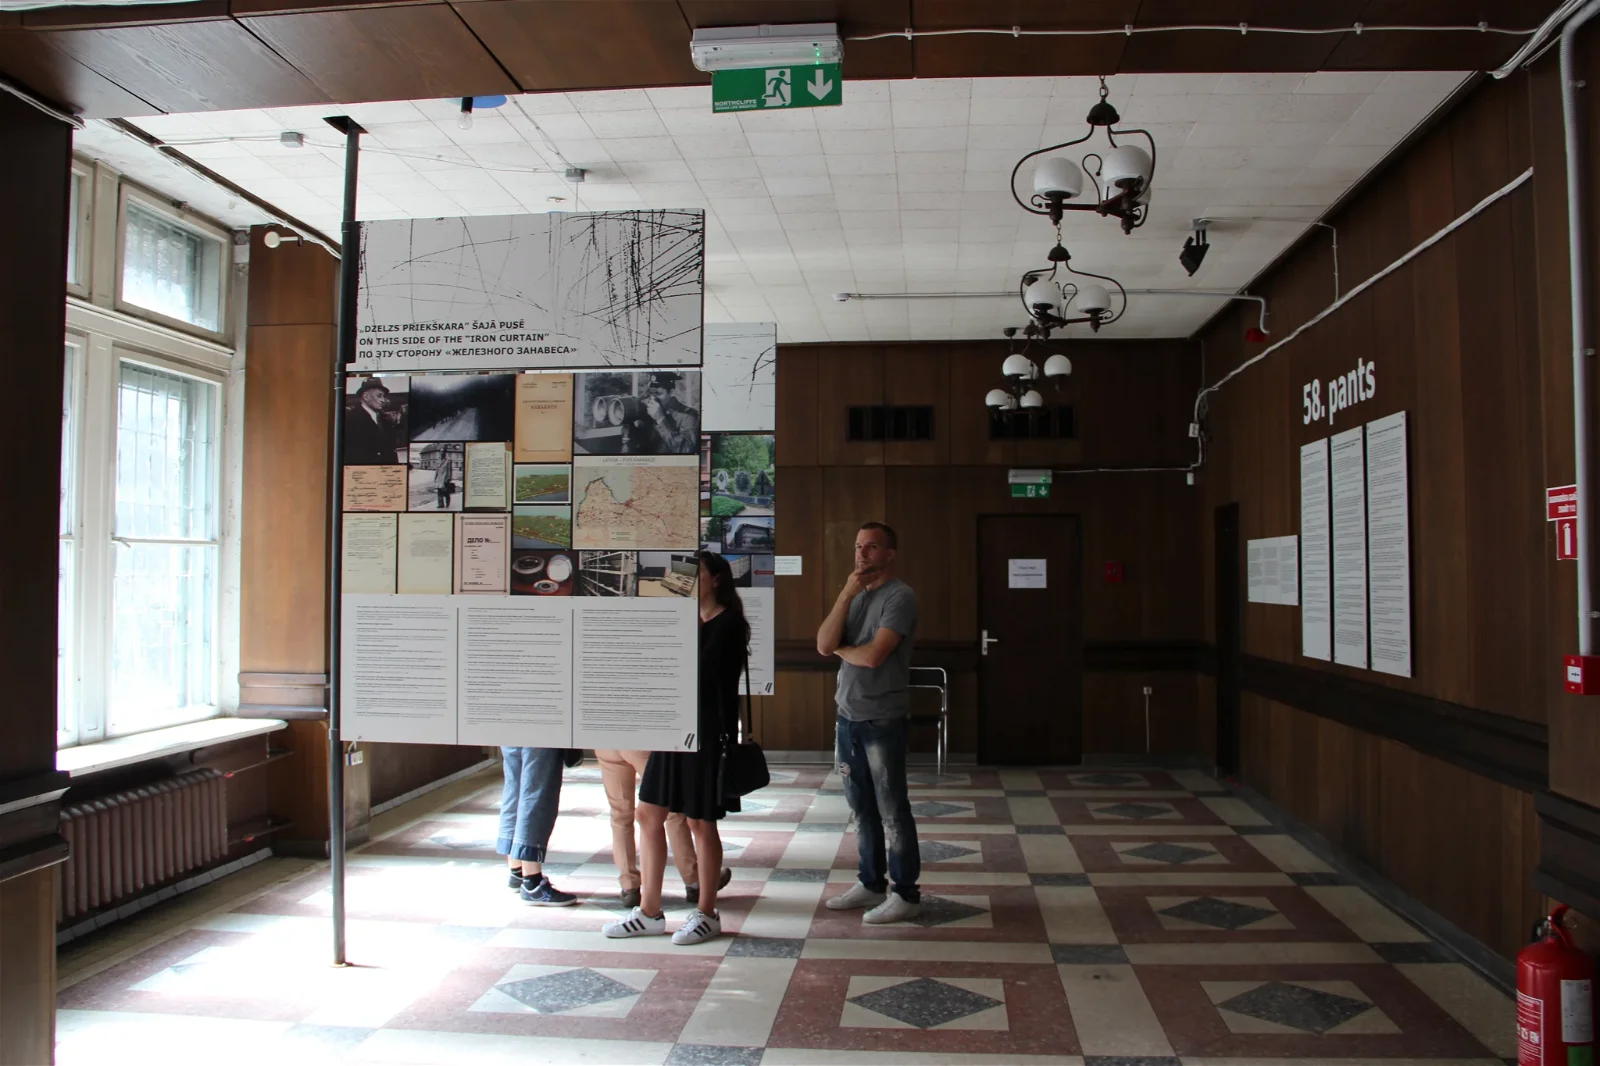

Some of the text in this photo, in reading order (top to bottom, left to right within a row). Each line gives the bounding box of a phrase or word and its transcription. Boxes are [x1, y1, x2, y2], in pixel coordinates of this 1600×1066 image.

[715, 99, 757, 107] NORTHCLIFFE
[472, 320, 497, 330] ŠAJĀ
[499, 318, 525, 329] PUSĒ
[359, 338, 373, 346] ON
[376, 337, 400, 345] THIS
[402, 336, 425, 345] SIDE
[428, 336, 441, 344] OF
[444, 335, 463, 344] THE
[359, 346, 577, 358] ПО ЭТУ СТОРОНУ «ЖЕЛЕЗНОГО ЗАНАВЕСА»
[1303, 357, 1376, 425] 58. pants
